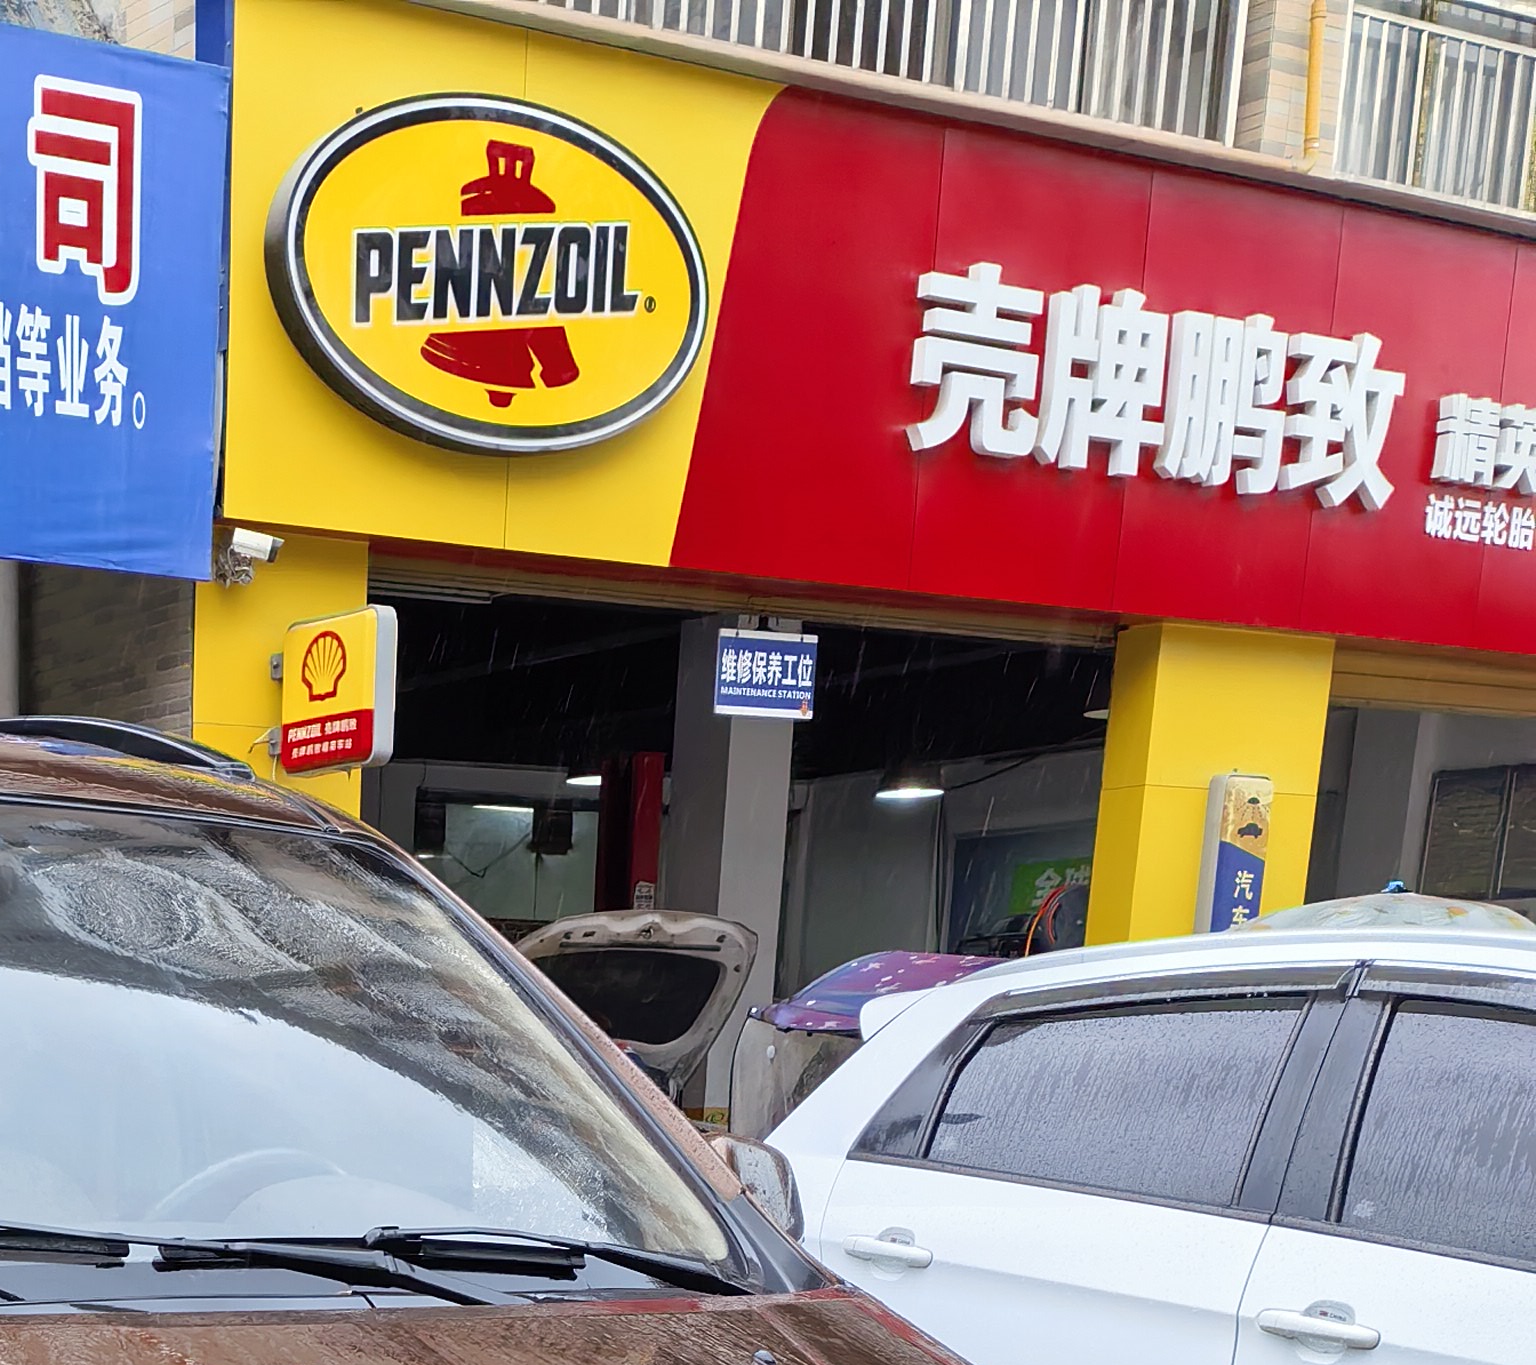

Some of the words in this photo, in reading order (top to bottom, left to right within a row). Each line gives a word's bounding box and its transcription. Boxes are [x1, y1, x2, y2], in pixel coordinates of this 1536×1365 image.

[352, 221, 644, 327] PENNZOIL
[906, 261, 1406, 511] 壳牌鹏致
[1424, 493, 1536, 550] 诚远轮胎
[720, 648, 814, 688] 维修保养工位
[720, 686, 778, 698] MAINTENANCE
[777, 689, 812, 700] STATION
